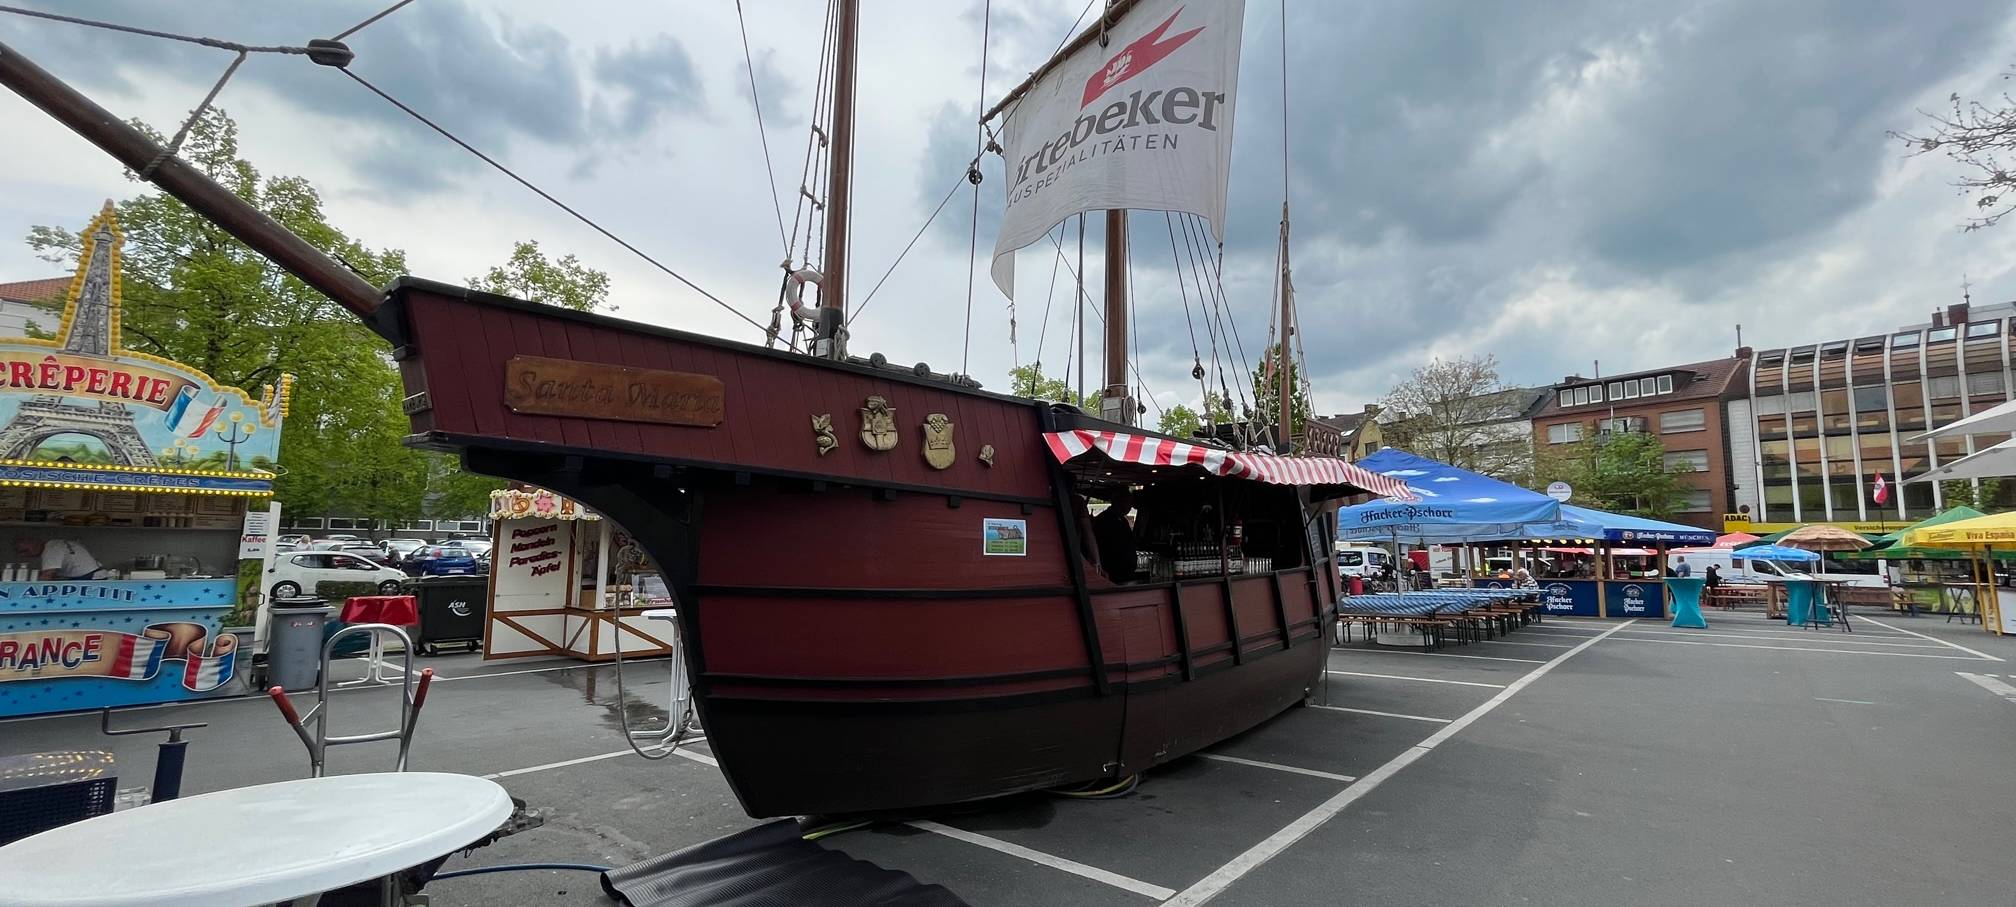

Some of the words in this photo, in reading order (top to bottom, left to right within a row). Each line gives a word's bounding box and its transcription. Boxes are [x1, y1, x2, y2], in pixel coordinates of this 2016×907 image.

[512, 370, 616, 404] Santa
[624, 382, 721, 413] Maria
[0, 467, 105, 483] ÖSISCHE
[1360, 504, 1454, 523] Hacker-Pschorr
[1725, 514, 1748, 522] ADAC
[512, 524, 558, 539] Popcorn
[1966, 531, 1984, 540] Viva
[510, 536, 556, 554] Mandeln
[531, 561, 561, 577] Äpfel
[23, 585, 136, 601] APPETIT
